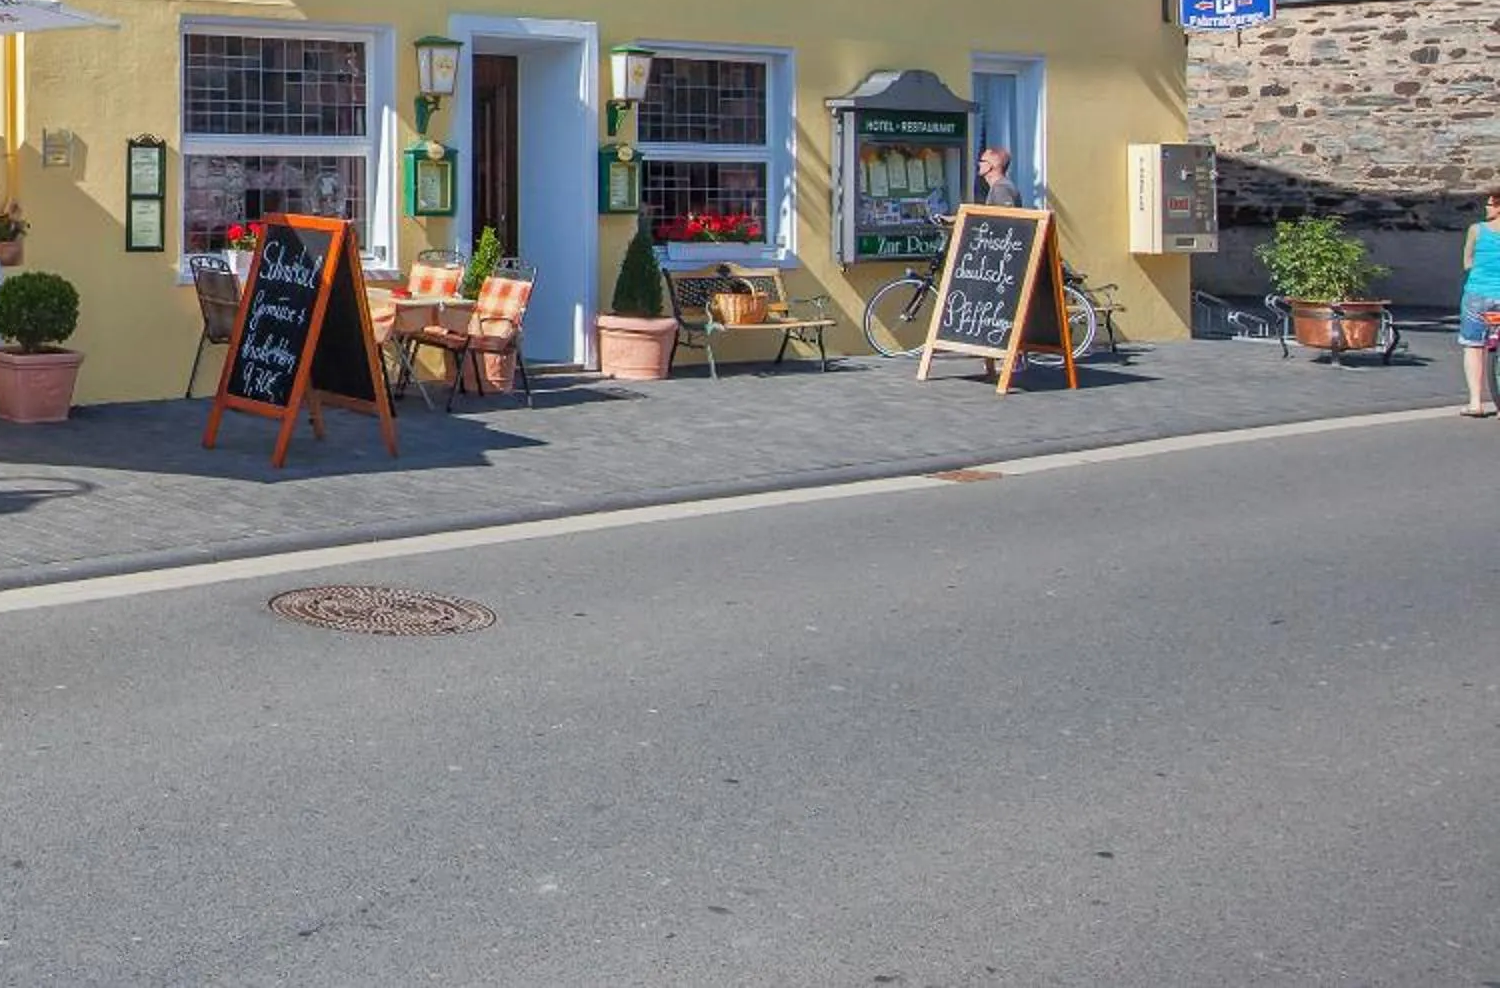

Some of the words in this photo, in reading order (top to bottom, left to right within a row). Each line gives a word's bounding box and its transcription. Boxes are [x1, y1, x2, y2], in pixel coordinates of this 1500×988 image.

[866, 119, 895, 133] HOTEL
[901, 120, 956, 133] RESTAURANT
[878, 234, 900, 256] Zur
[906, 234, 941, 253] Pos
[970, 222, 1023, 261] Frische
